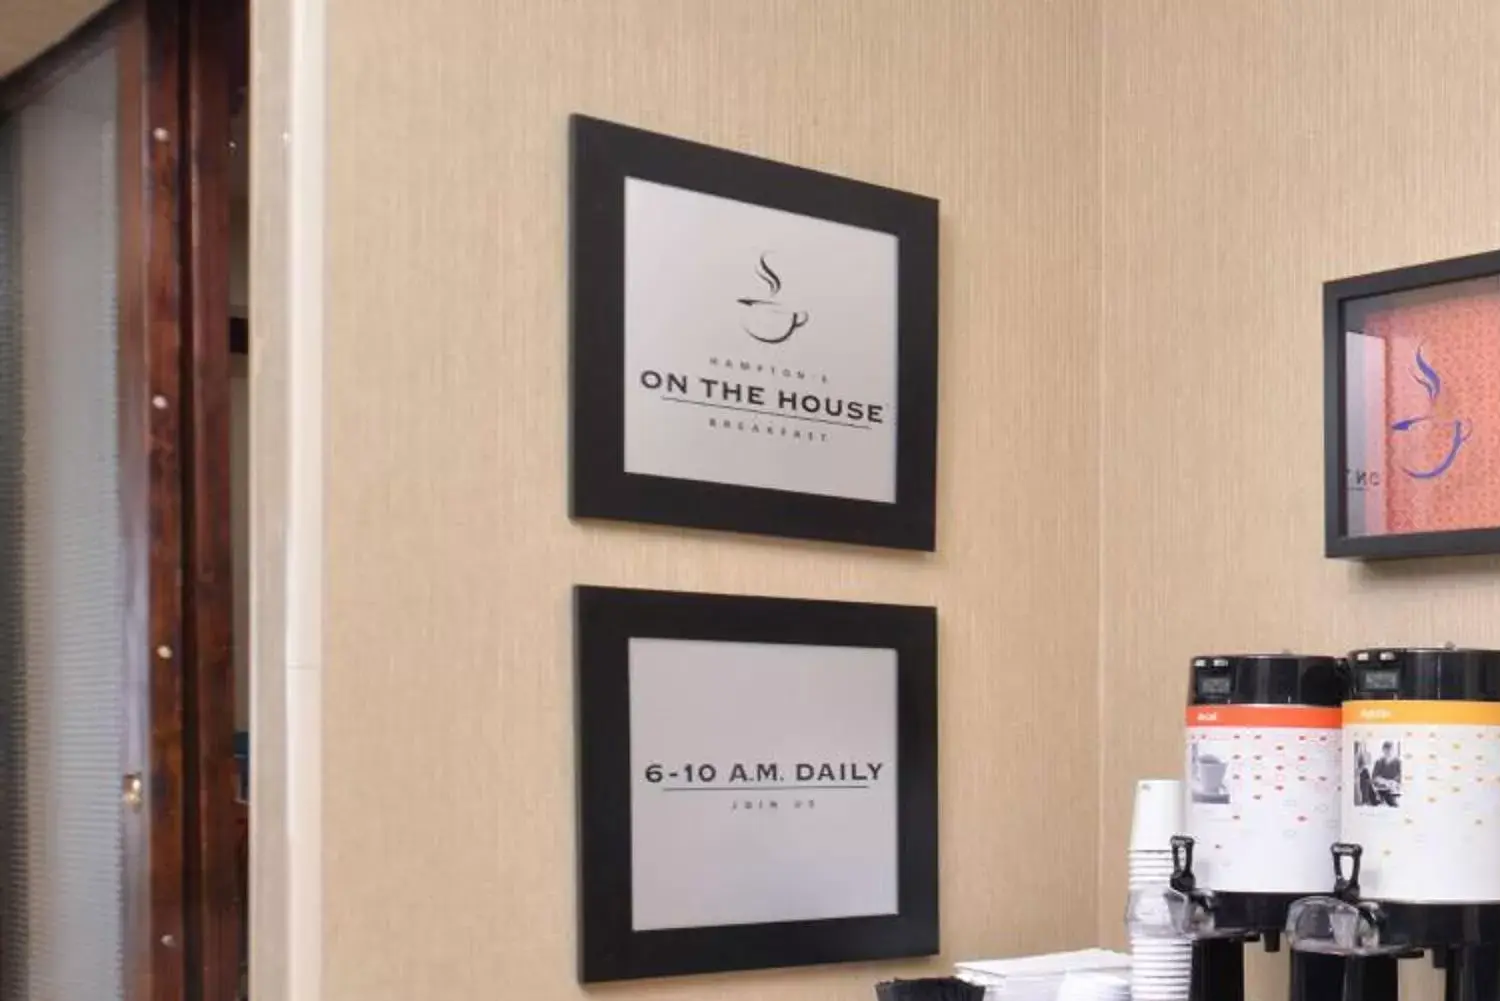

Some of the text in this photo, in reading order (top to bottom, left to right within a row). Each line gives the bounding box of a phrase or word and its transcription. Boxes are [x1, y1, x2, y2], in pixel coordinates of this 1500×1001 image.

[640, 369, 884, 424] ON THE HOUSE
[644, 762, 884, 783] 6-10 A.M. DAILY
